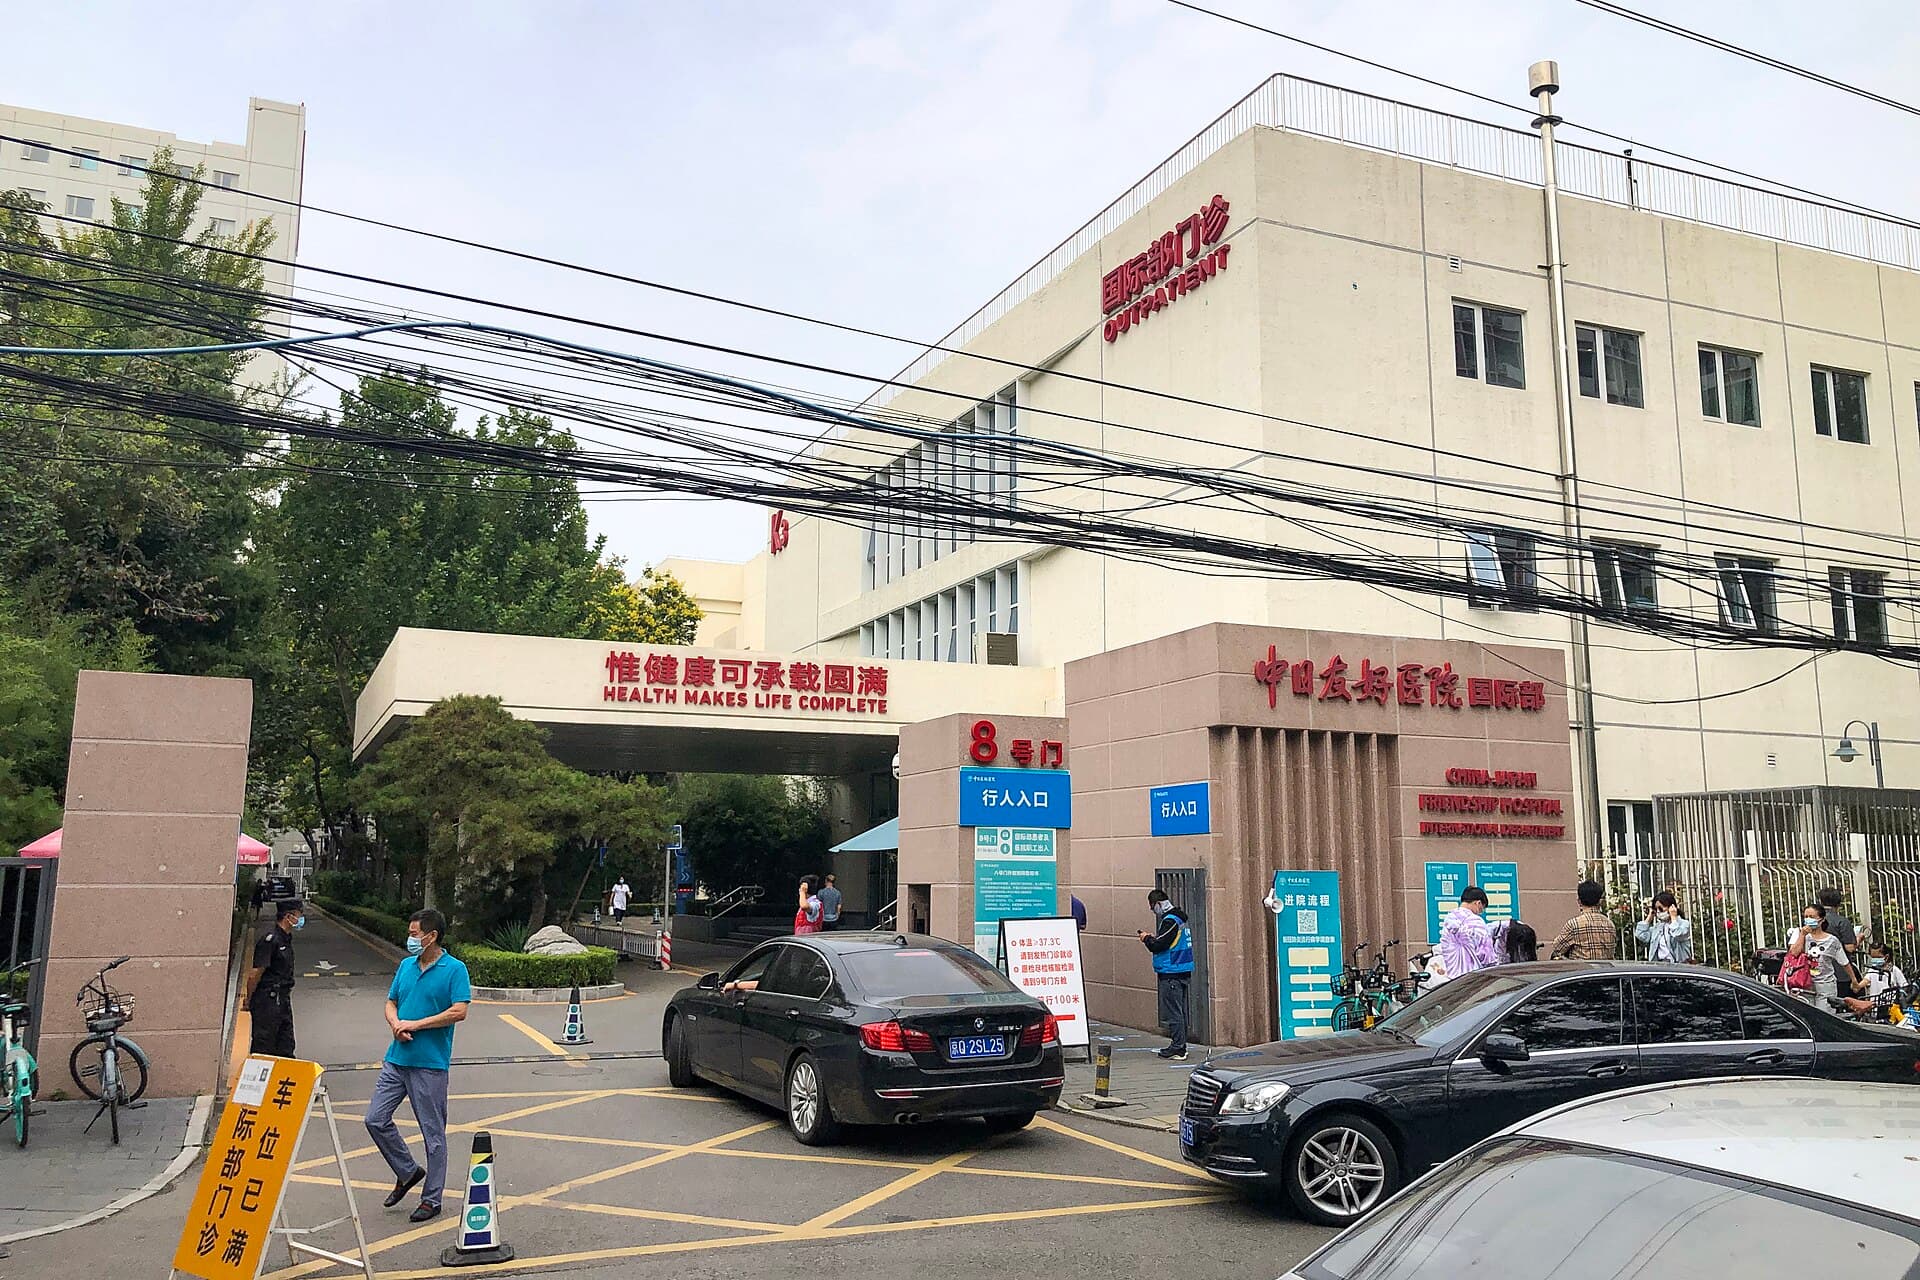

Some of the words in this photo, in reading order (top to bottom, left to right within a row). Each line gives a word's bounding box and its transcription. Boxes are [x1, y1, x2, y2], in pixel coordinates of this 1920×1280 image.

[1103, 194, 1230, 314] 国际部门诊
[1103, 244, 1231, 343] OUTPATIENT
[605, 651, 888, 696] 惟健康可承载圆满
[604, 686, 677, 704] HEALTH
[684, 690, 748, 707] MAKES
[755, 693, 792, 709] LIFE
[799, 695, 888, 714] COMPLETE
[982, 789, 1048, 808] 行人入口
[1161, 800, 1197, 818] 行人入口
[1419, 794, 1499, 813] FRIENDSHIP
[1284, 894, 1330, 907] 进院流程
[222, 1077, 296, 1268] 车位已满
